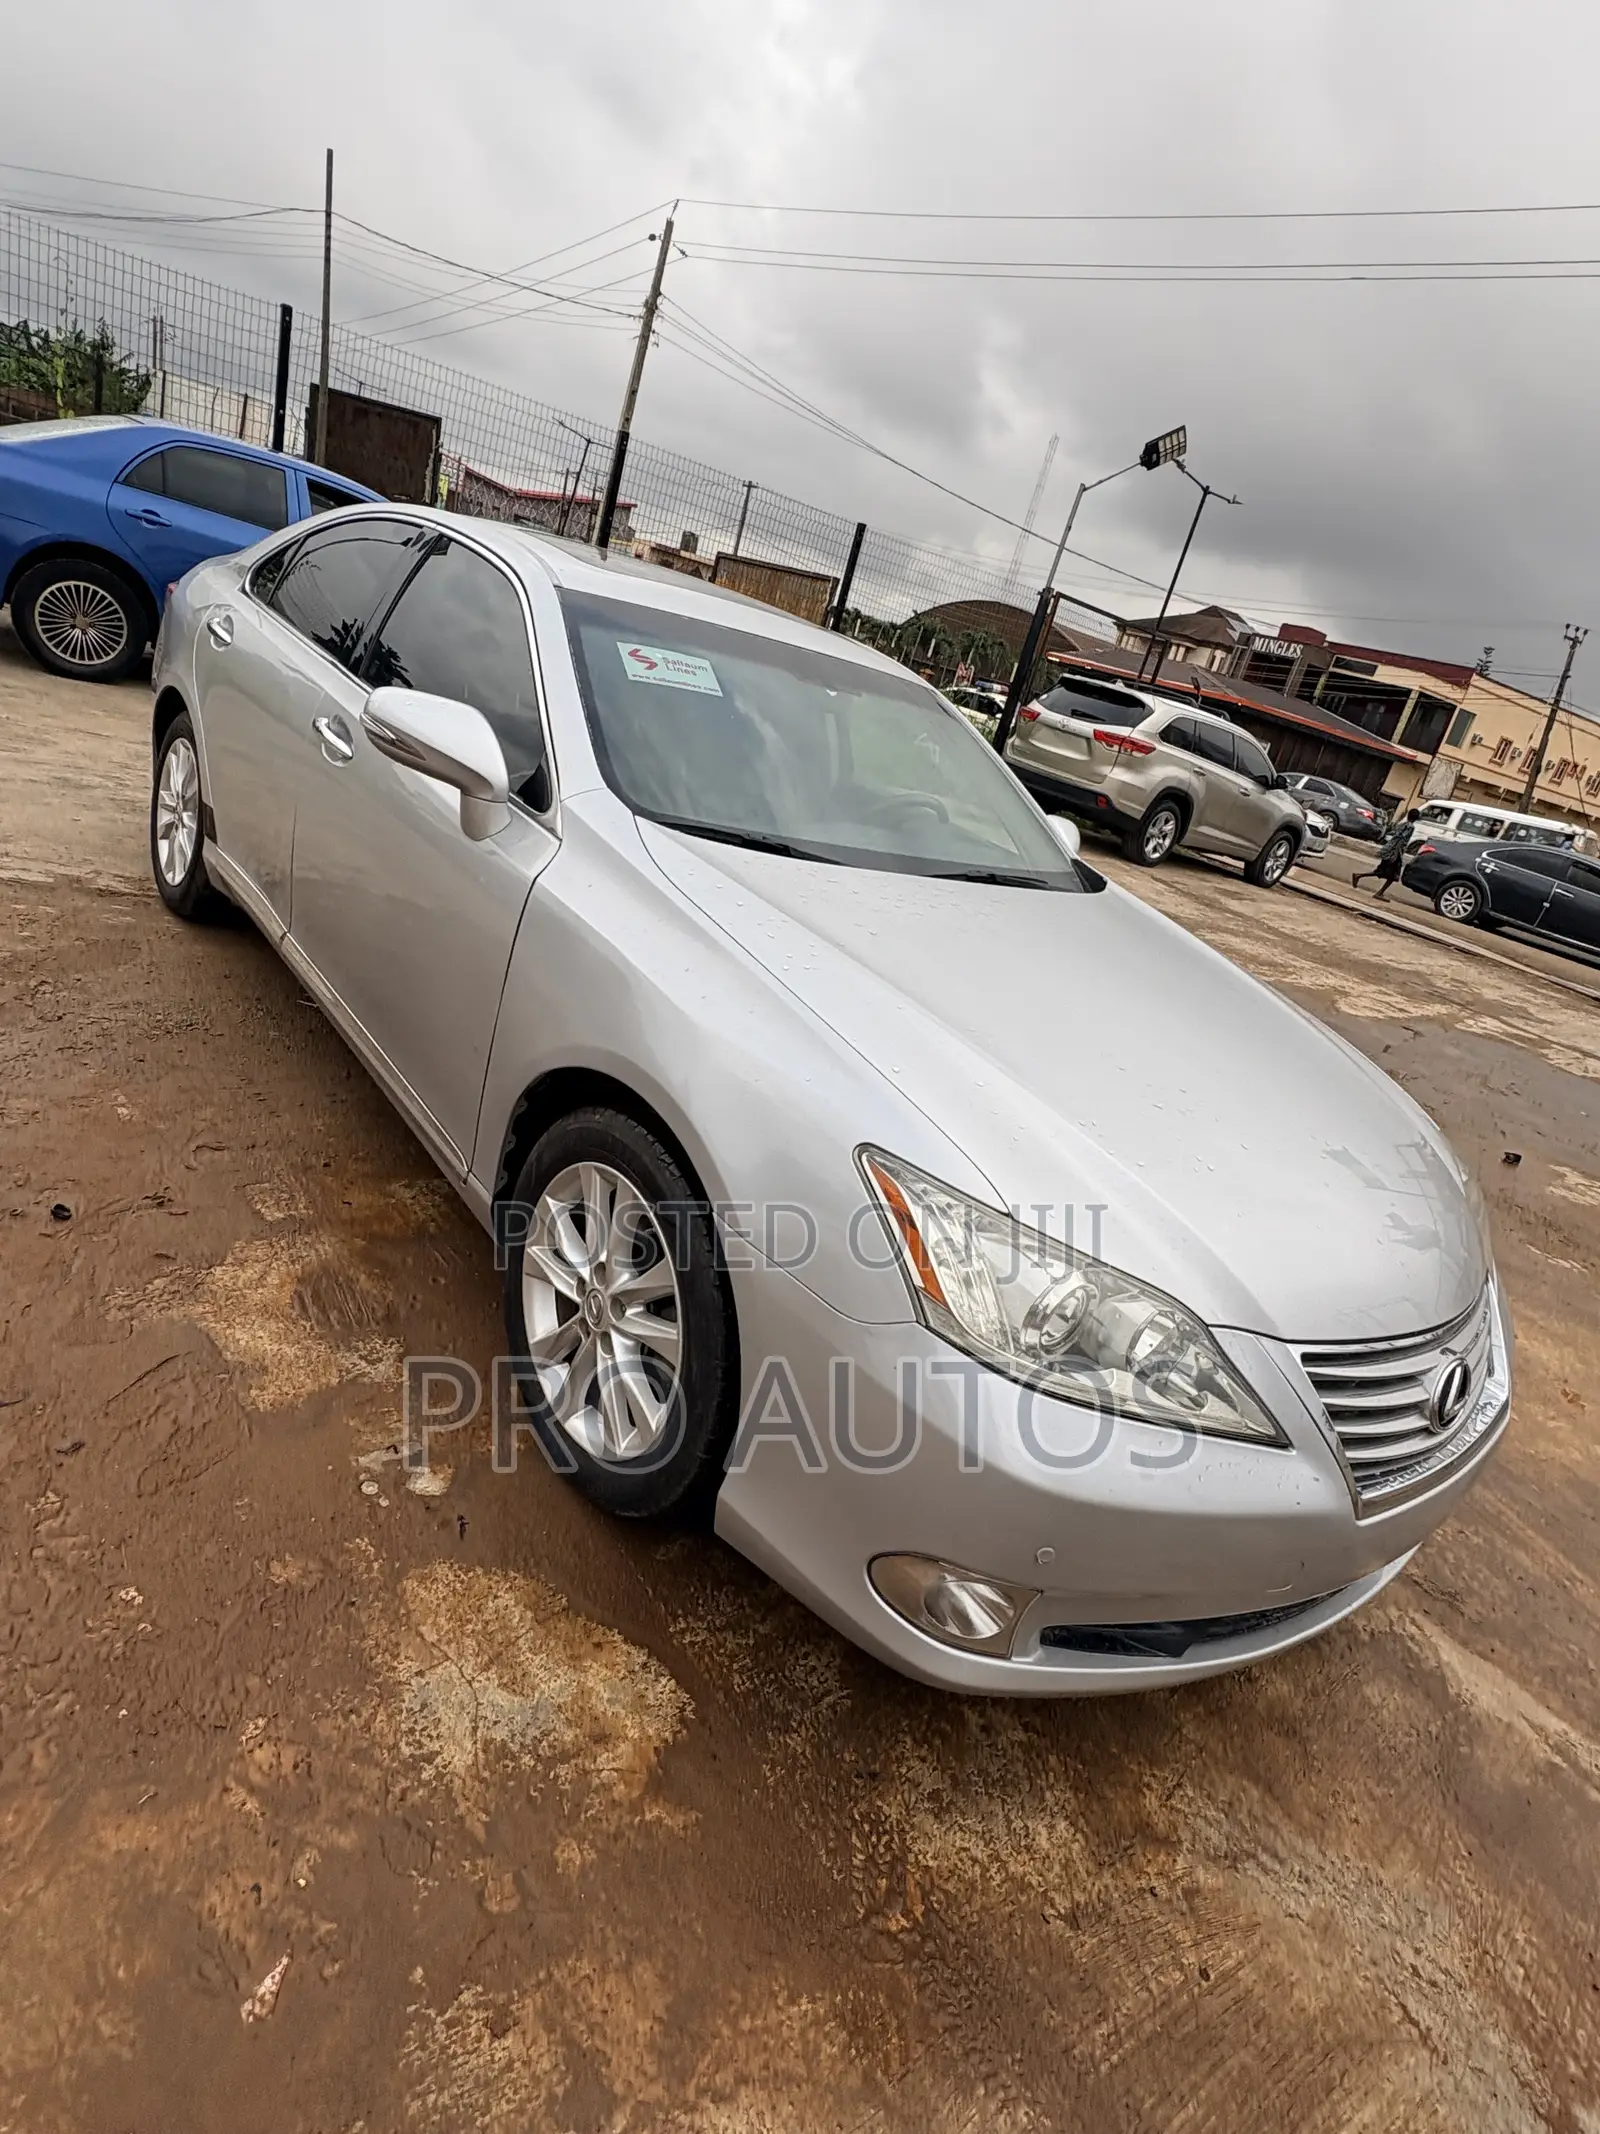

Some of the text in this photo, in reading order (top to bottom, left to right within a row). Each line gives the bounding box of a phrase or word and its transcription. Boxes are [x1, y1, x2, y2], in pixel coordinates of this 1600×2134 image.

[1252, 636, 1304, 659] MINGLES
[661, 656, 708, 672] Sallaum
[665, 663, 697, 676] Lines
